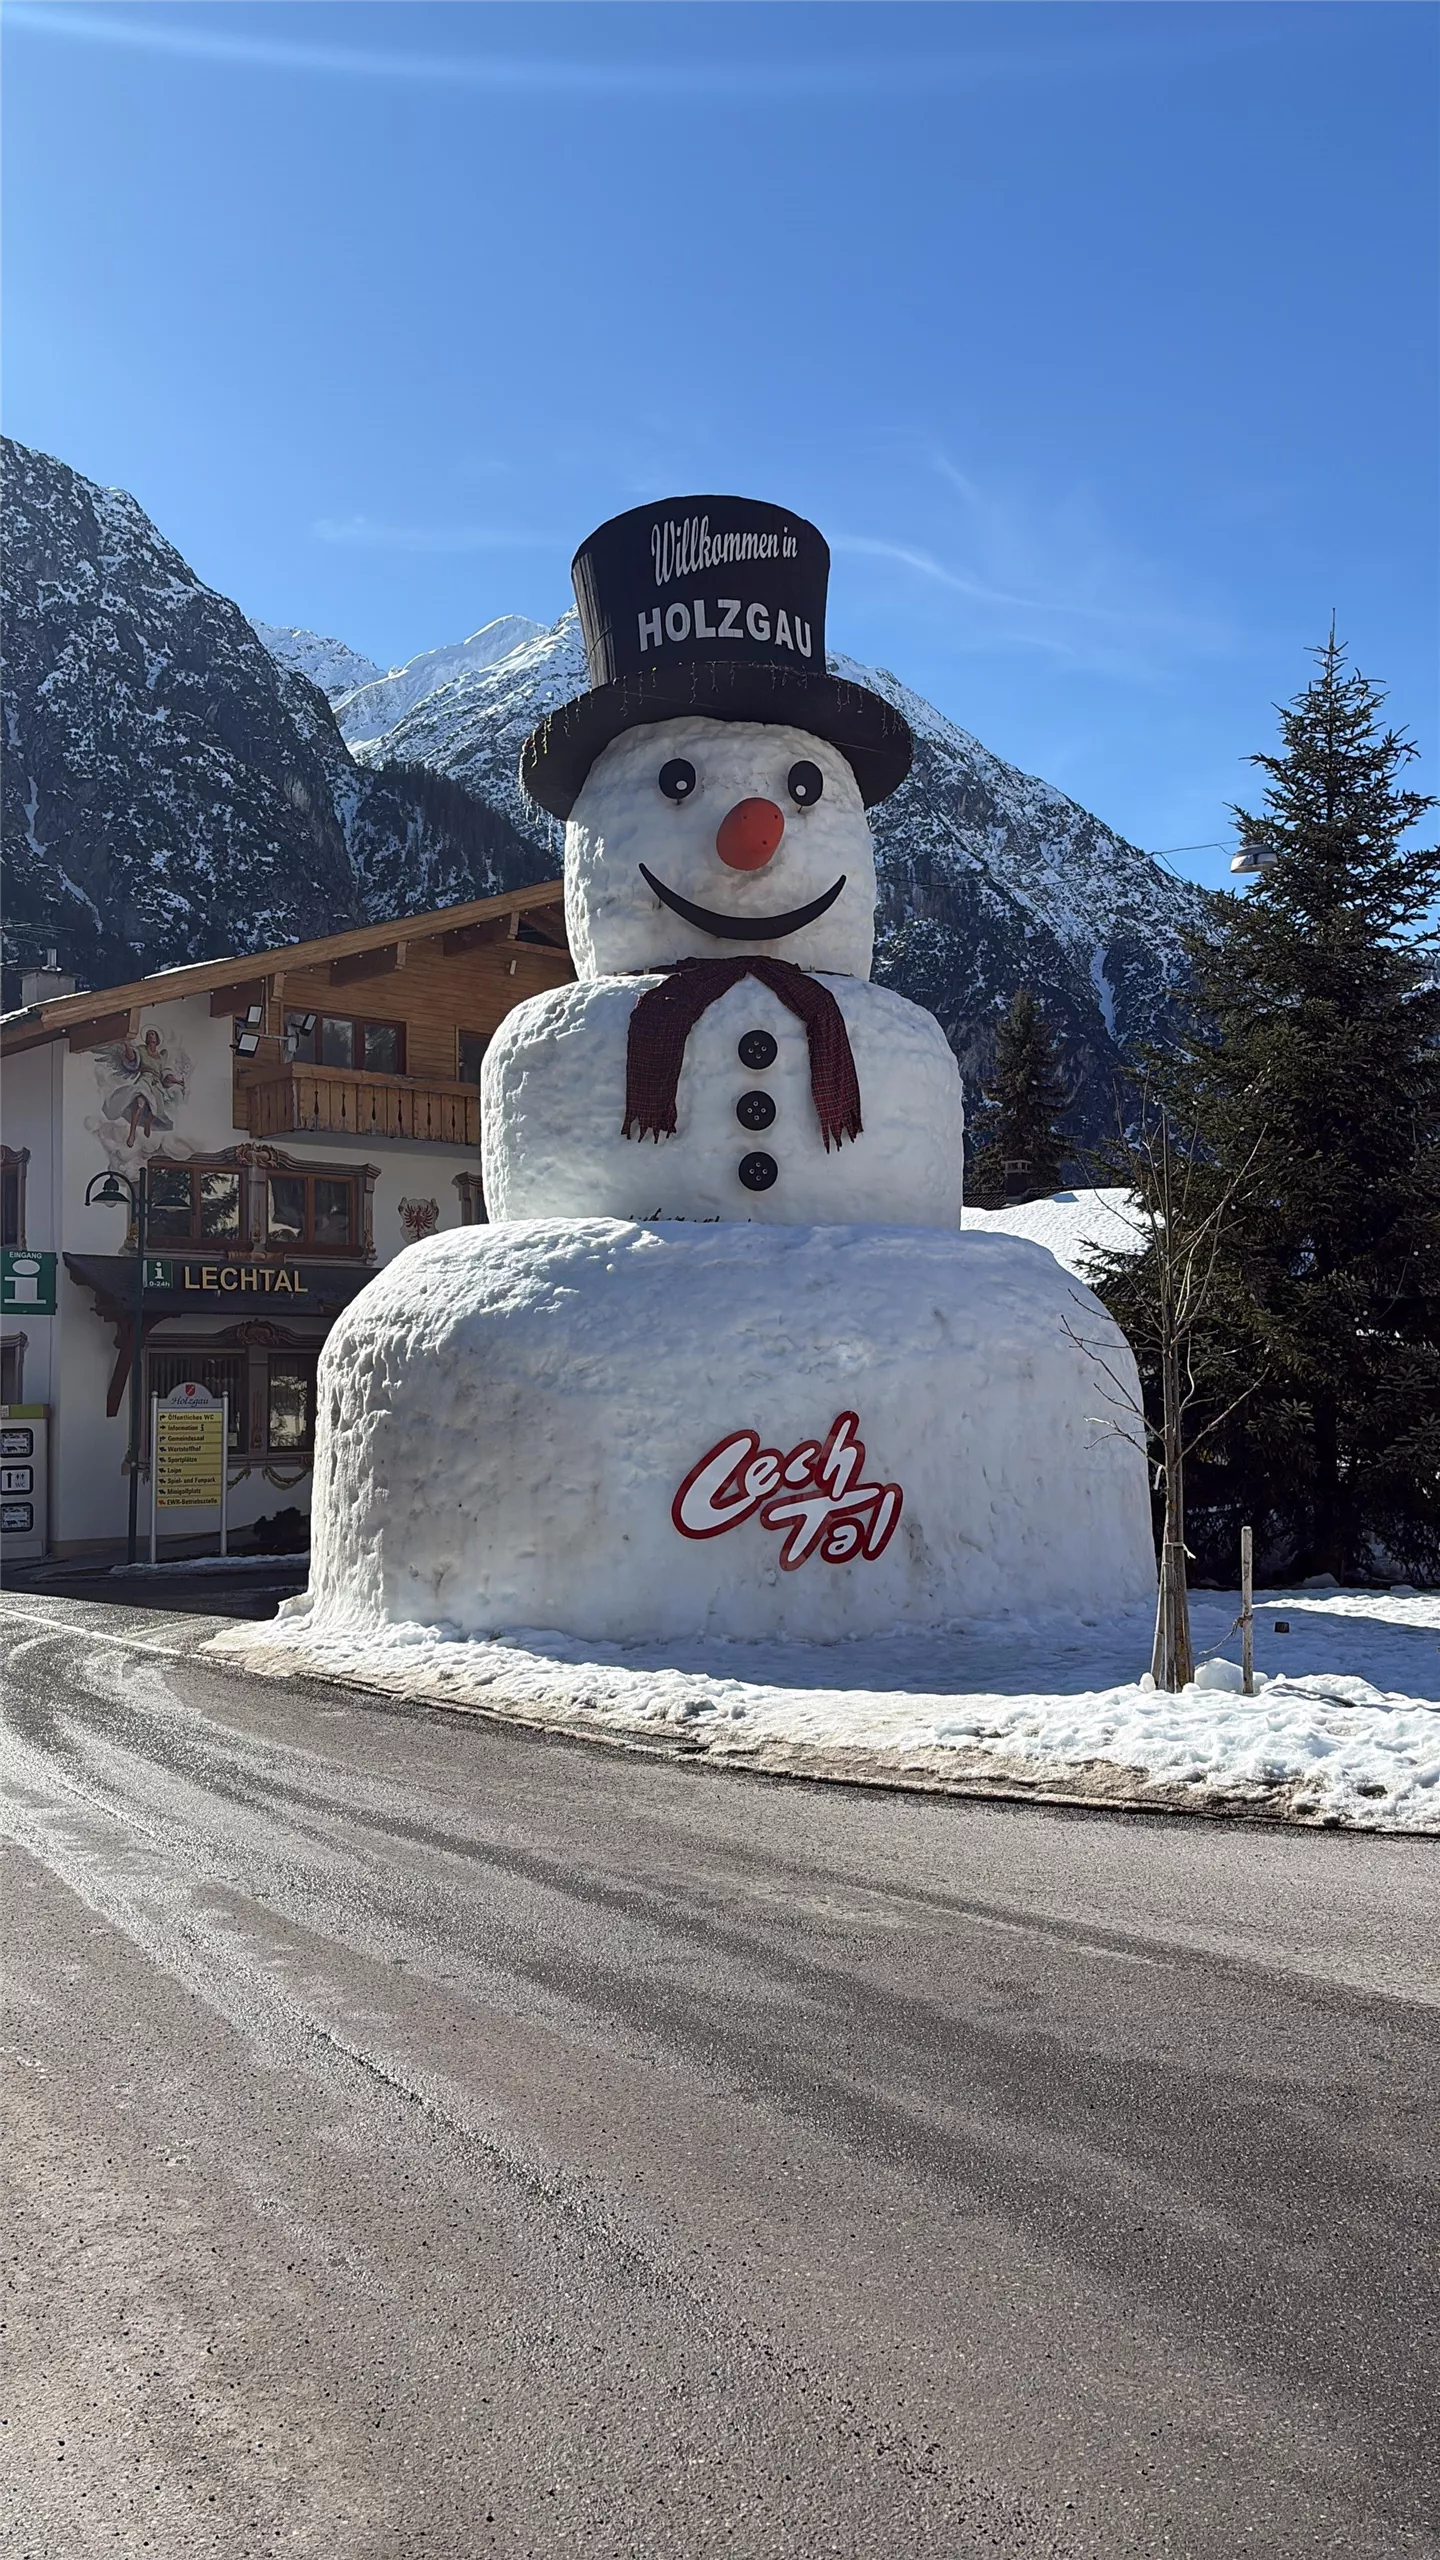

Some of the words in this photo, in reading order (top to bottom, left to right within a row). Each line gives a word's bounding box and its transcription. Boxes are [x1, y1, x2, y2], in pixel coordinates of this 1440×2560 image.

[651, 515, 780, 586] Willkommen
[782, 526, 798, 558] in
[637, 599, 812, 658] HOLZGAU
[9, 1251, 42, 1259] EINGANG
[184, 1266, 309, 1293] LECHTAL
[170, 1396, 209, 1408] Holzgau
[168, 1413, 203, 1421] Öffentliches
[759, 1482, 903, 1572] Tal
